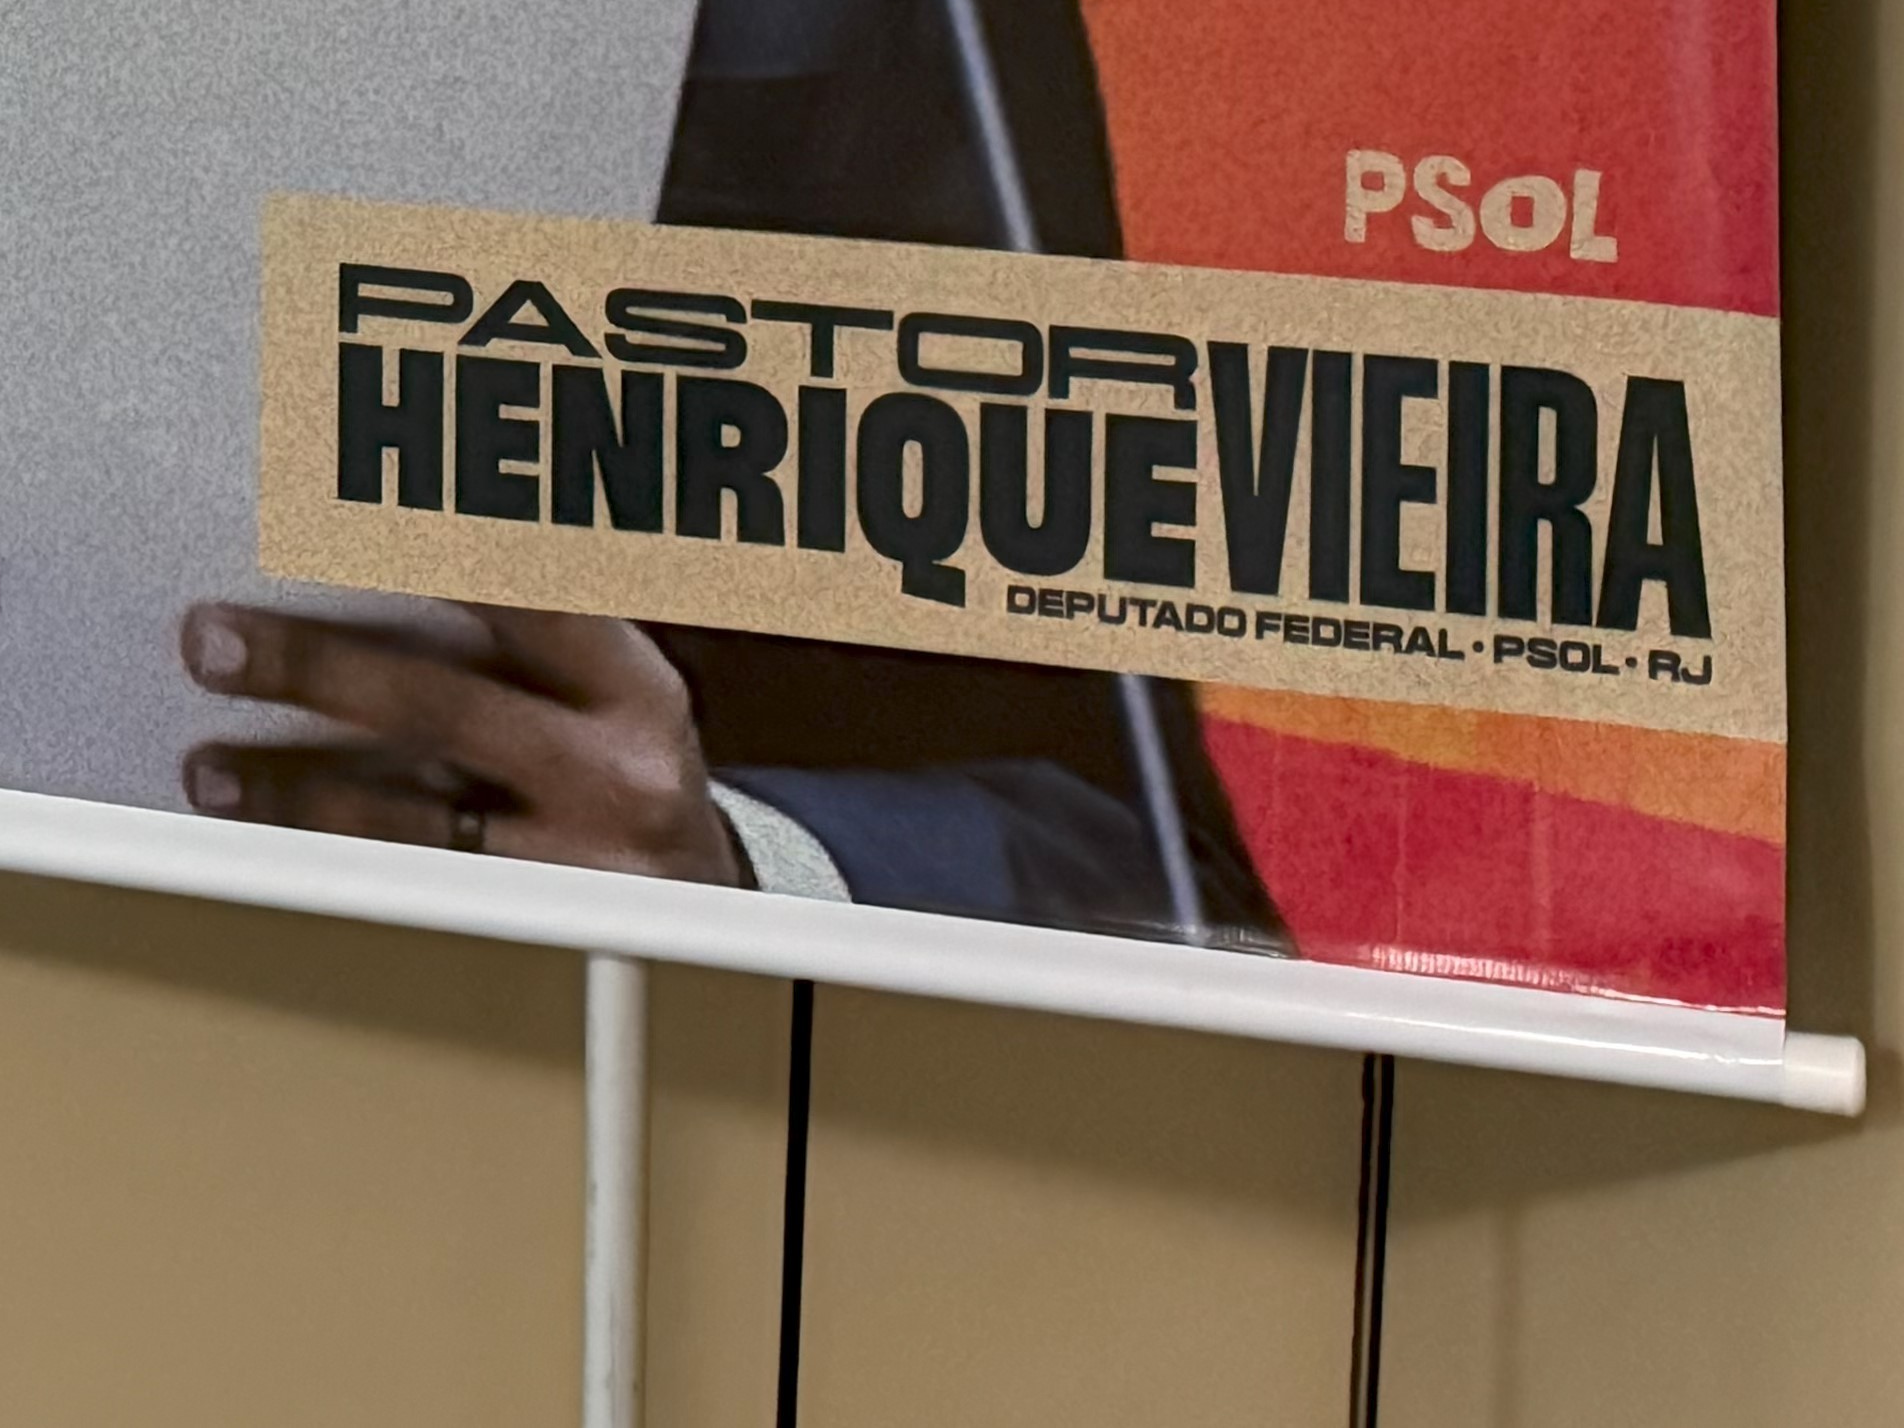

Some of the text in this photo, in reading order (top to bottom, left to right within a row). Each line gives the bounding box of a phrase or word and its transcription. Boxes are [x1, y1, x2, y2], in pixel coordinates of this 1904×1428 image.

[338, 262, 1198, 410] PASTOR
[1006, 585, 1713, 685] DEPUTADO FEDERAL PSOL RJ
